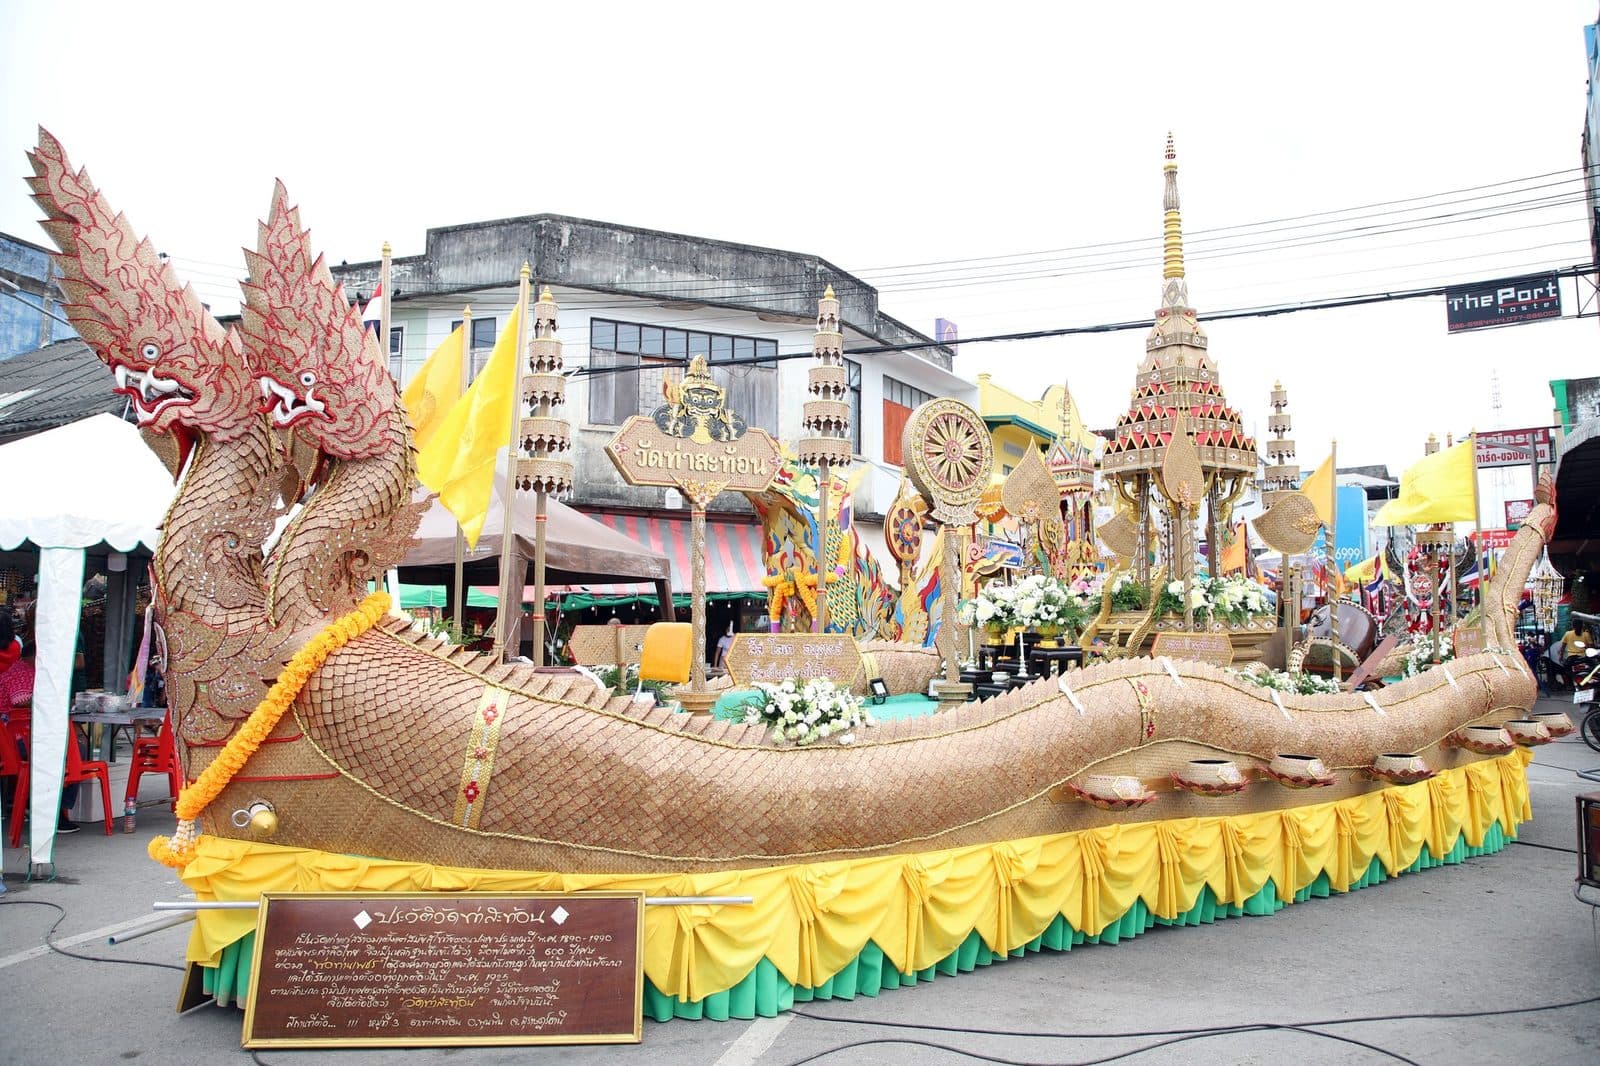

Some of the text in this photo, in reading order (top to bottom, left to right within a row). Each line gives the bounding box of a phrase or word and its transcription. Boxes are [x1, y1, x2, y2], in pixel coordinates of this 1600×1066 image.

[1497, 281, 1557, 305] Port
[1499, 299, 1559, 314] hostel
[633, 438, 768, 476] วัดท่าสะท้อน
[374, 905, 545, 925] ประวัติวัดท่าสะท้อน
[545, 947, 565, 956] 600
[391, 1018, 400, 1028] 3
